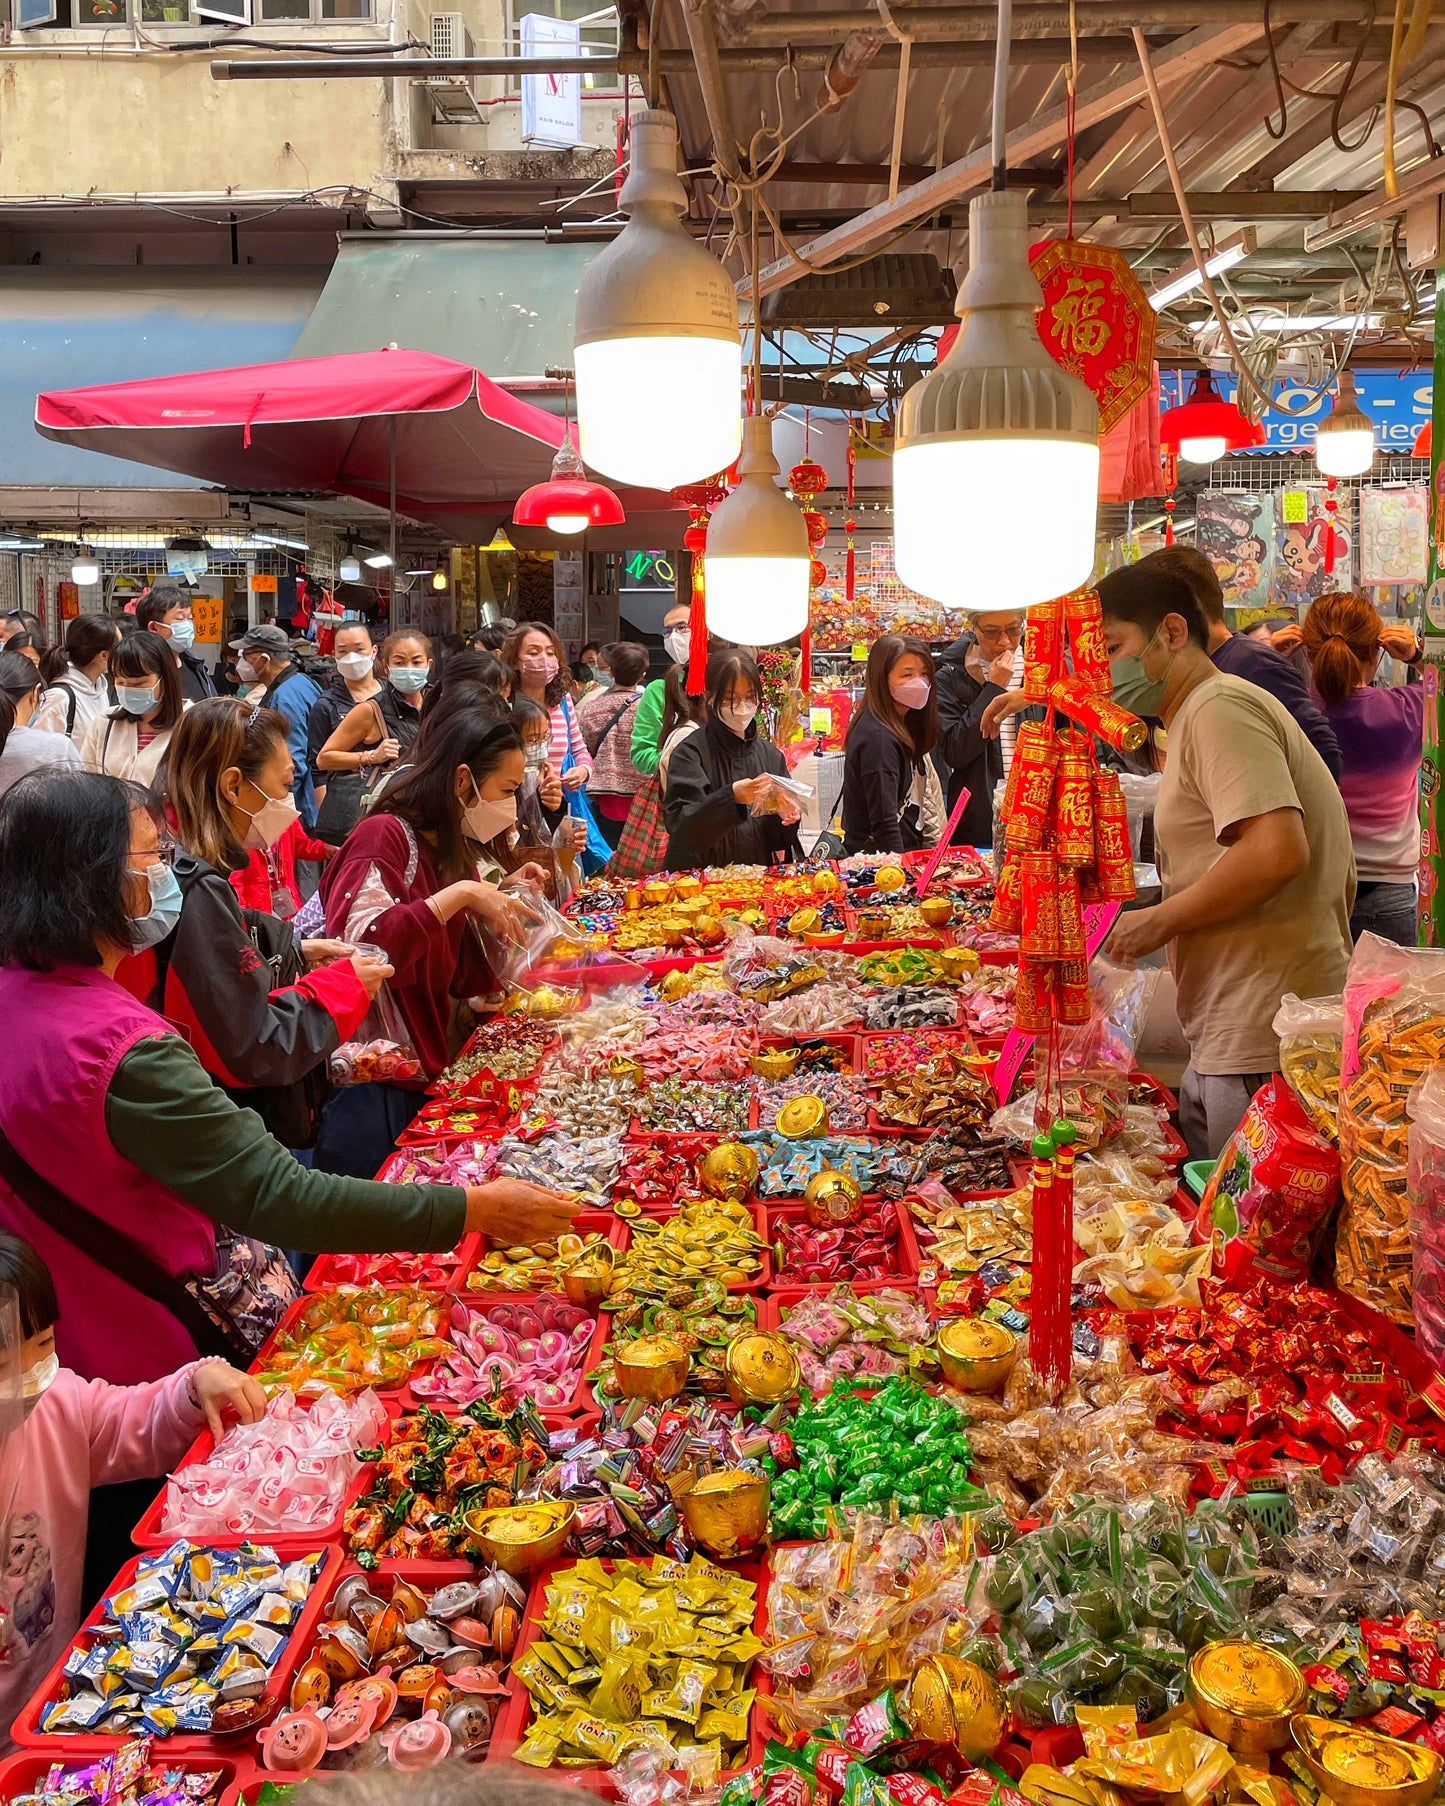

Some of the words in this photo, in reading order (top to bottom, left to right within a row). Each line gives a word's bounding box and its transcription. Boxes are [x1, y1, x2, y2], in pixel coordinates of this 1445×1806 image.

[555, 119, 574, 127] SALON
[1051, 276, 1112, 356] 福
[1286, 510, 1304, 521] $50
[1075, 618, 1108, 665] 福
[1059, 781, 1092, 826] 福
[1291, 1168, 1329, 1193] 100
